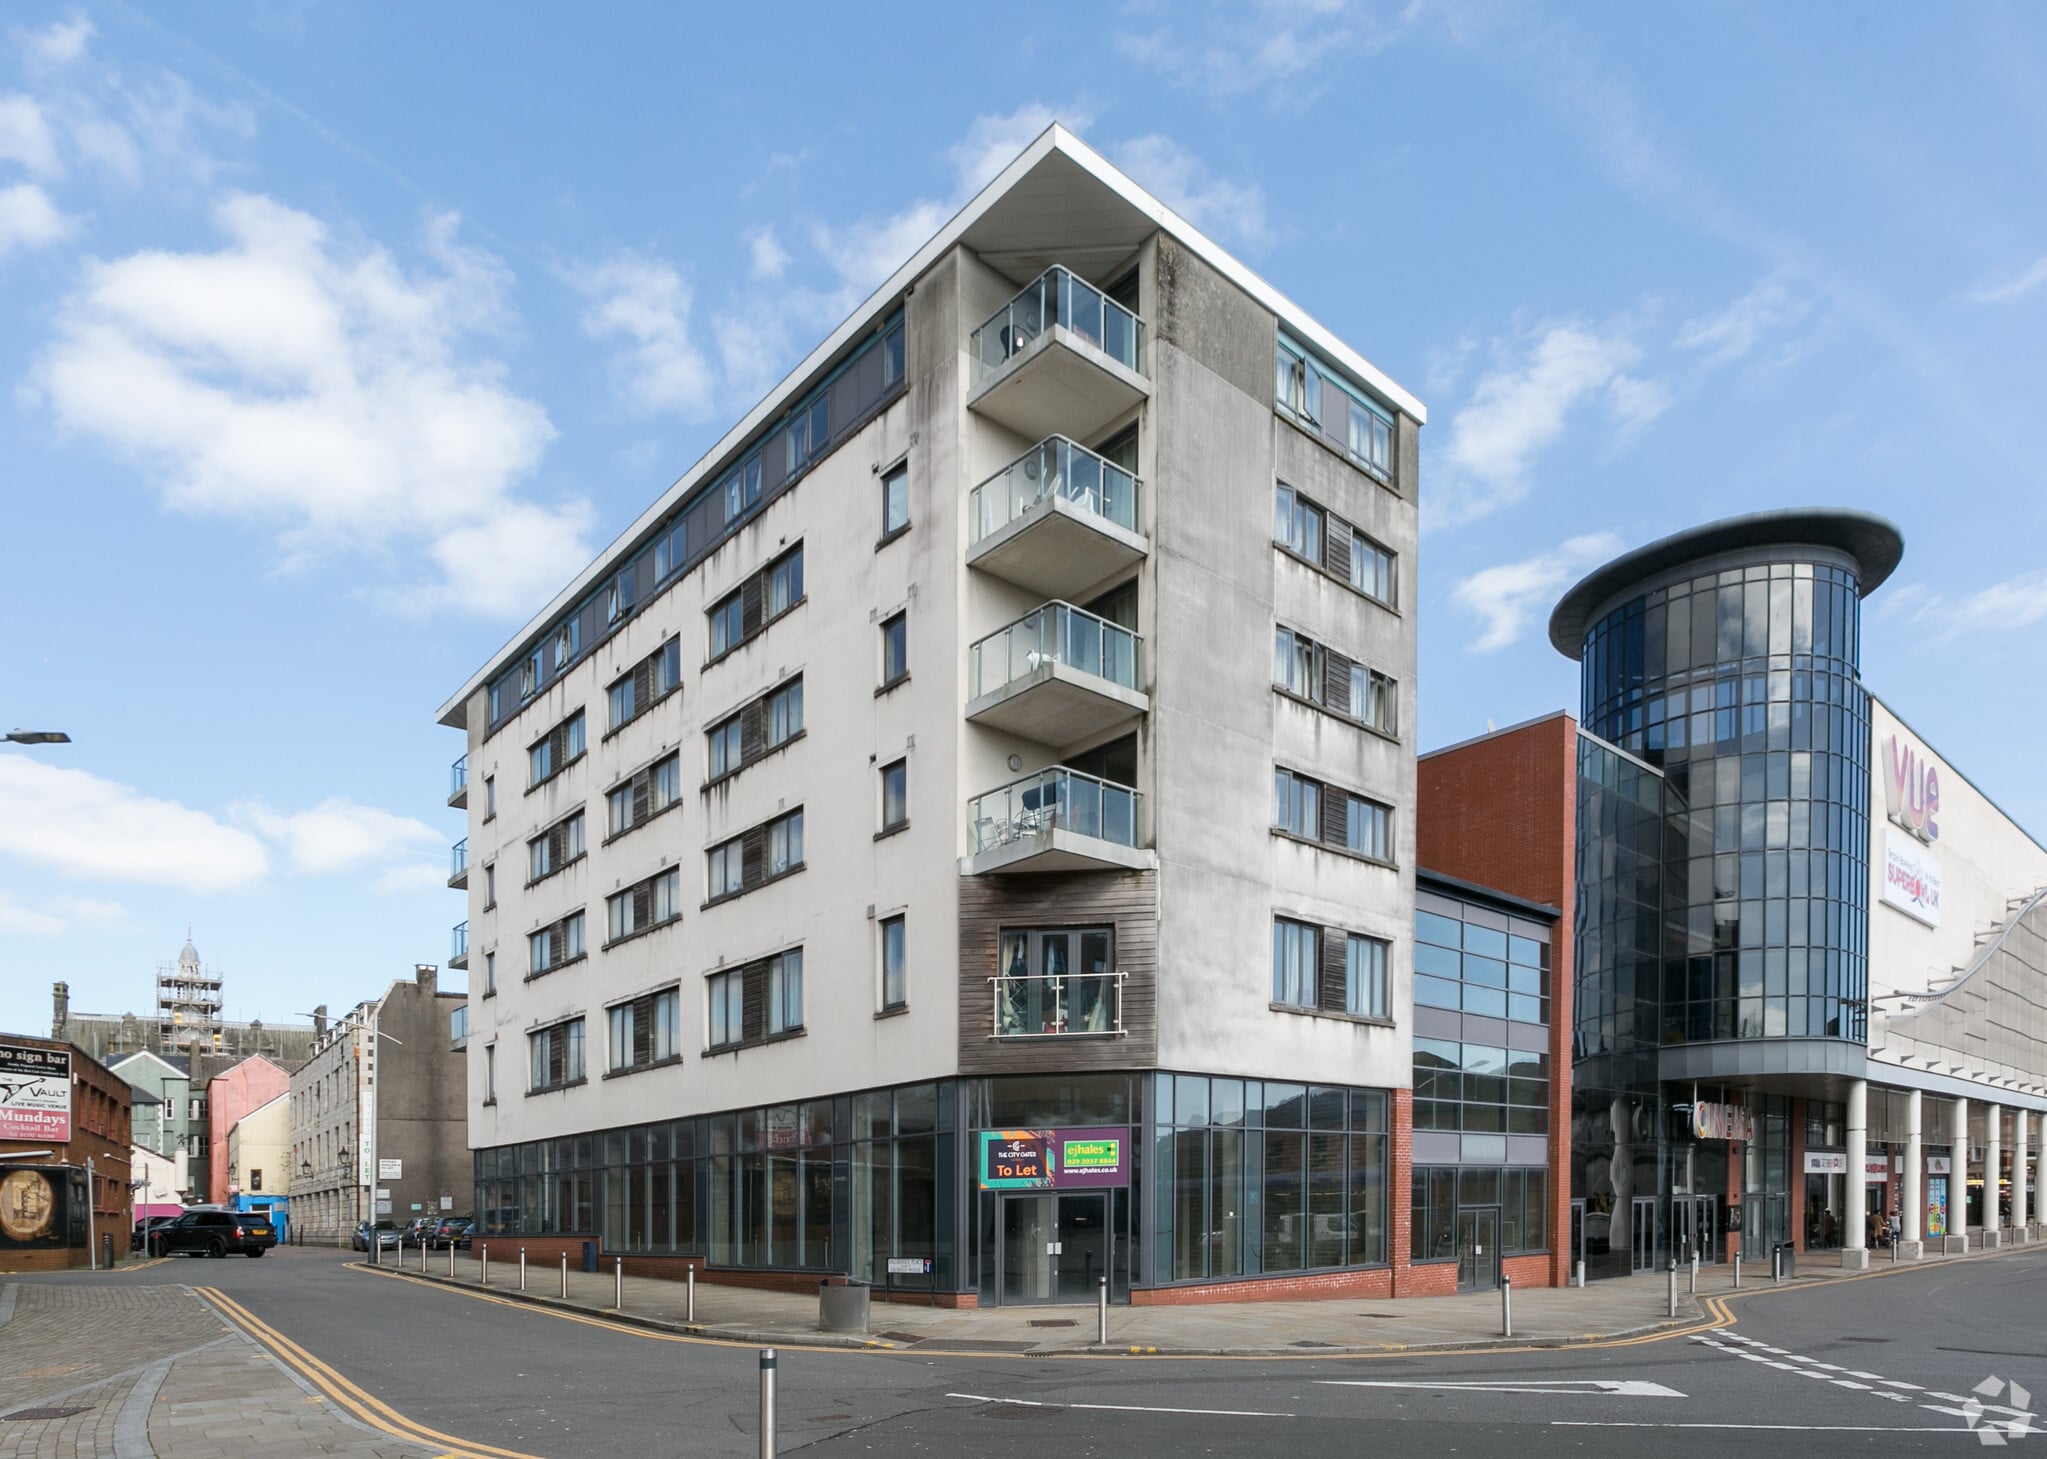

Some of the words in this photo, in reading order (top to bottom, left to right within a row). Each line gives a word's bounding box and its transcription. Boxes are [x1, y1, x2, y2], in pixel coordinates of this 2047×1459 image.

[16, 1050, 42, 1064] sign
[47, 1052, 67, 1065] bar
[29, 1087, 67, 1098] VAULT
[0, 1109, 66, 1127] Mundays
[1693, 1101, 1753, 1141] CINEMA
[3, 1122, 41, 1131] Cocktail
[44, 1125, 60, 1133] Bar
[364, 1141, 371, 1154] TO
[1067, 1144, 1104, 1157] ejhales
[996, 1165, 1013, 1177] To
[1016, 1164, 1037, 1176] Let
[1064, 1166, 1118, 1175] www.ejhales.co.uk
